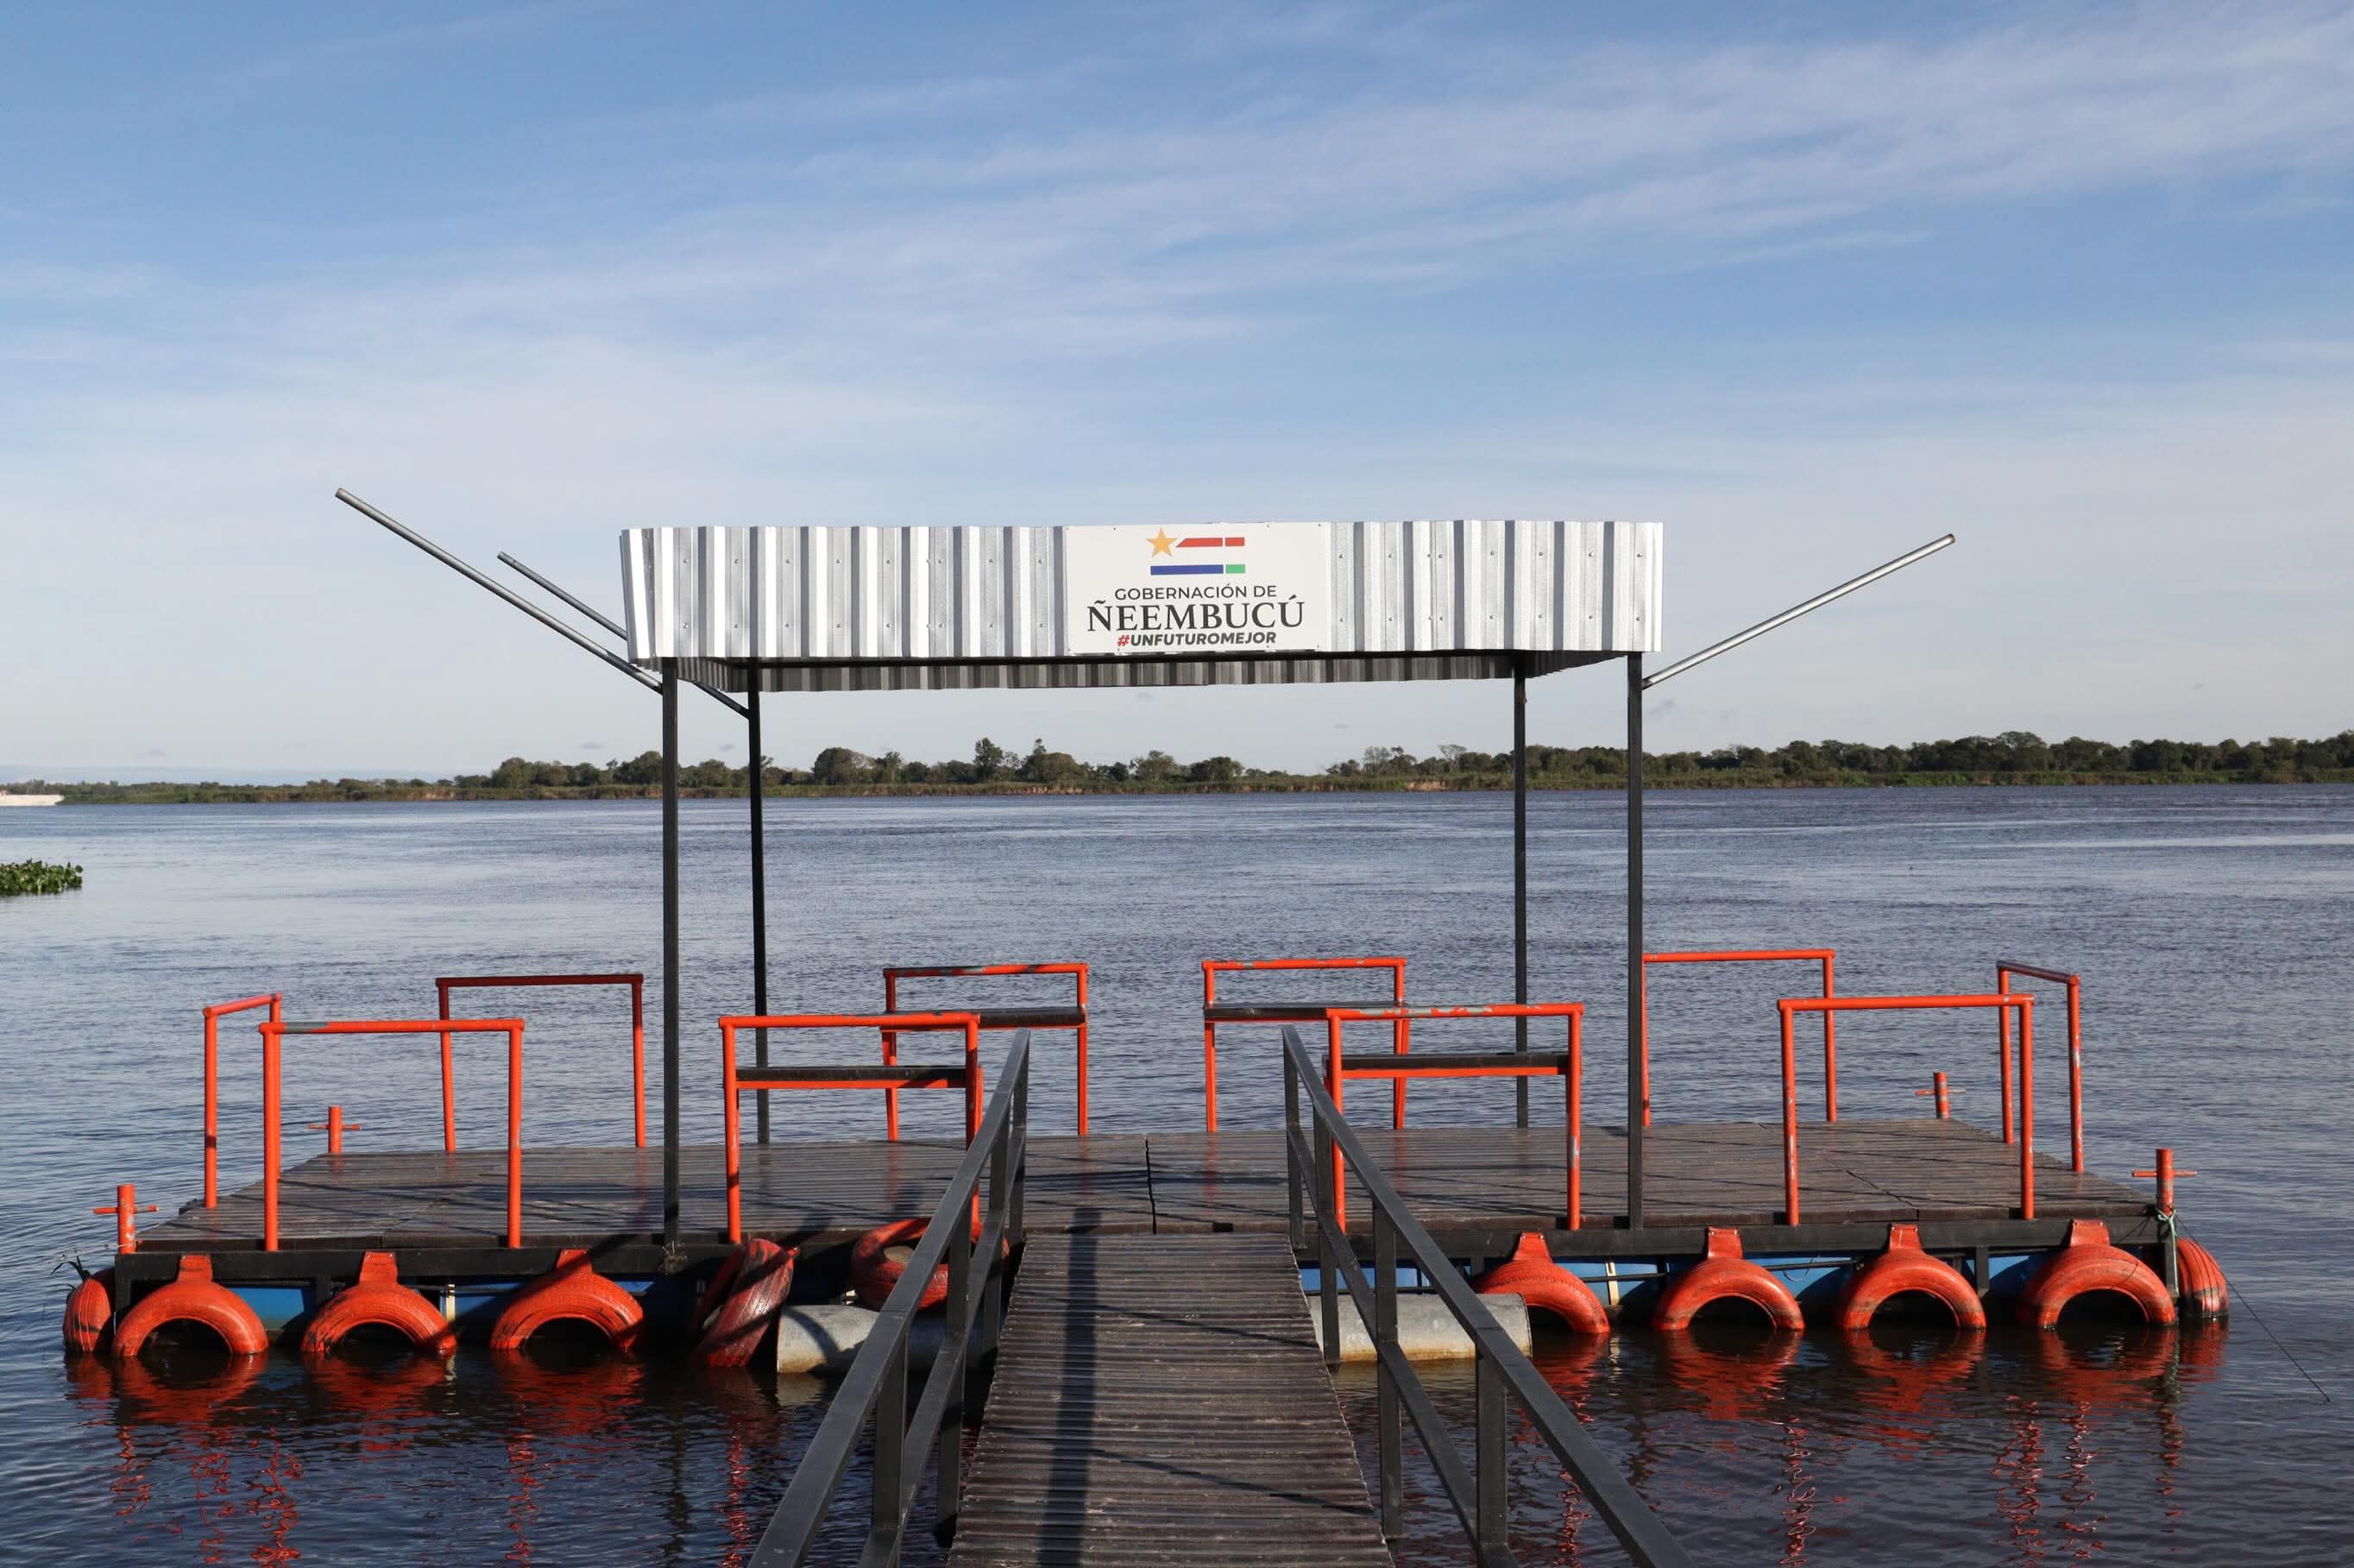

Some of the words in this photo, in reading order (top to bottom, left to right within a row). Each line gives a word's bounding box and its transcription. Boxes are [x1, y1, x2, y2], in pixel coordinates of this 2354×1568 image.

[1114, 583, 1247, 601] GOBERNACIÓN
[1253, 585, 1277, 598] DE
[1087, 595, 1305, 632] ÑEEMBUCÚ
[1117, 631, 1277, 646] #UNFUTUROMEJOR
